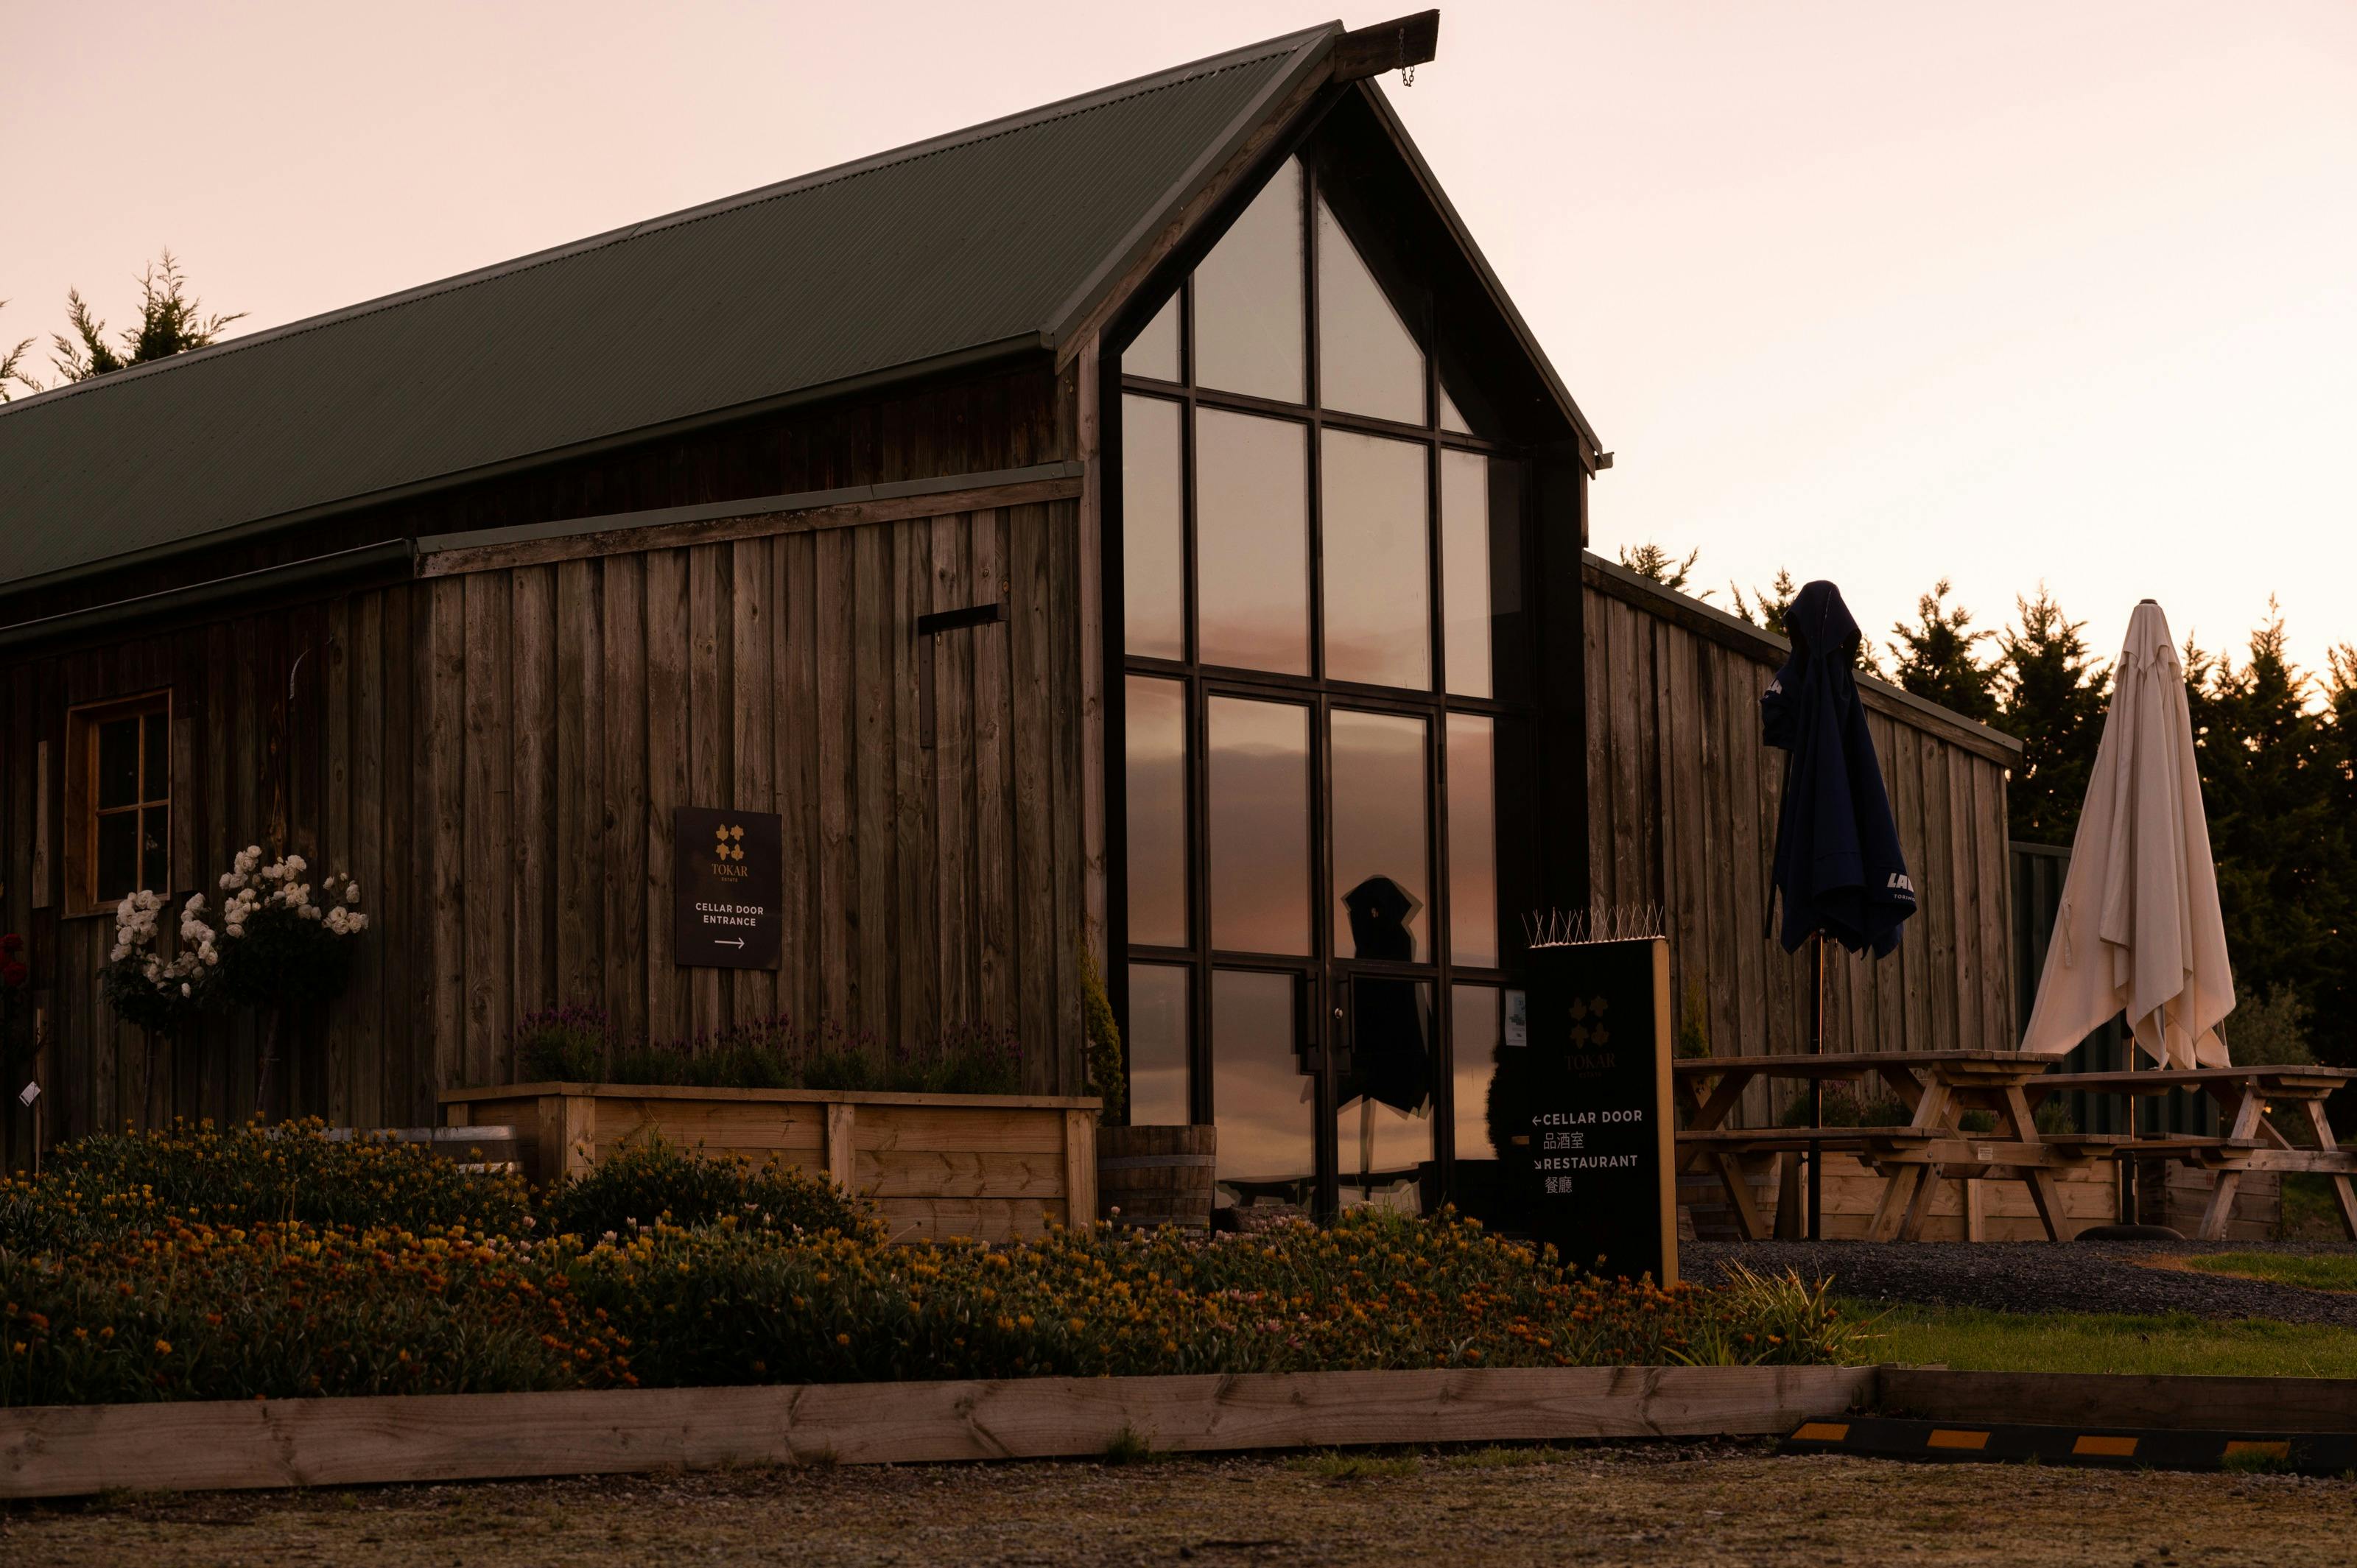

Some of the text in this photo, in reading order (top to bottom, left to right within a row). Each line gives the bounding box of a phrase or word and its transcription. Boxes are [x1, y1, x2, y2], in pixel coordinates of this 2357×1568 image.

[712, 863, 748, 877] TOKAR
[695, 902, 764, 915] CELLAR DOOR
[703, 915, 756, 927] ENTRANCE
[1564, 1052, 1617, 1070] TOKAR
[1543, 1110, 1643, 1125] CELLAR DOOR
[1543, 1131, 1584, 1150] 品酒室
[1544, 1155, 1638, 1170] RESTAURANT
[1545, 1175, 1573, 1194] 餐廳
